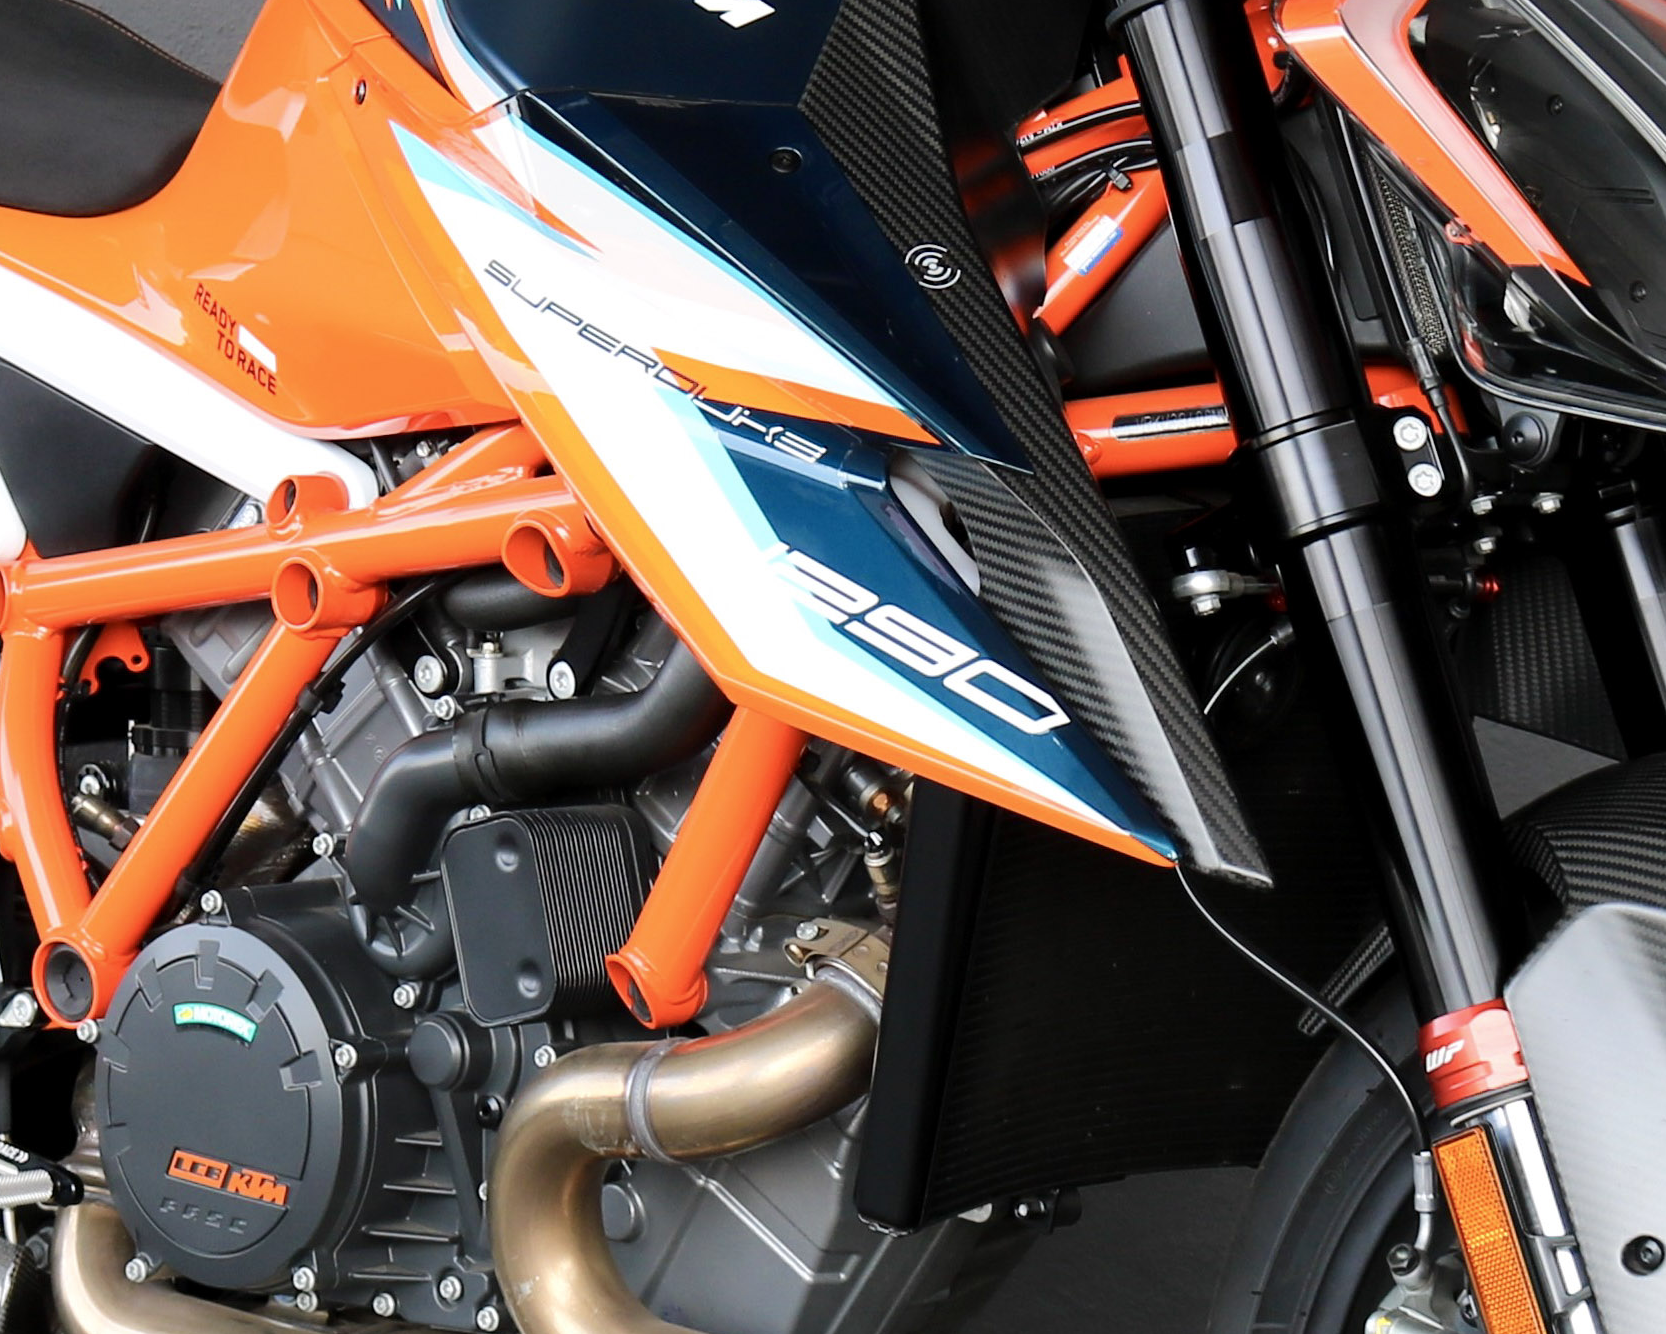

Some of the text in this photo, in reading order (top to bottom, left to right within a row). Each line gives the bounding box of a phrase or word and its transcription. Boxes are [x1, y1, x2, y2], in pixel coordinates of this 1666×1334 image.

[193, 282, 237, 336] READY
[216, 330, 277, 396] TO RACE
[1425, 1039, 1465, 1074] WP
[226, 1168, 289, 1206] KTM
